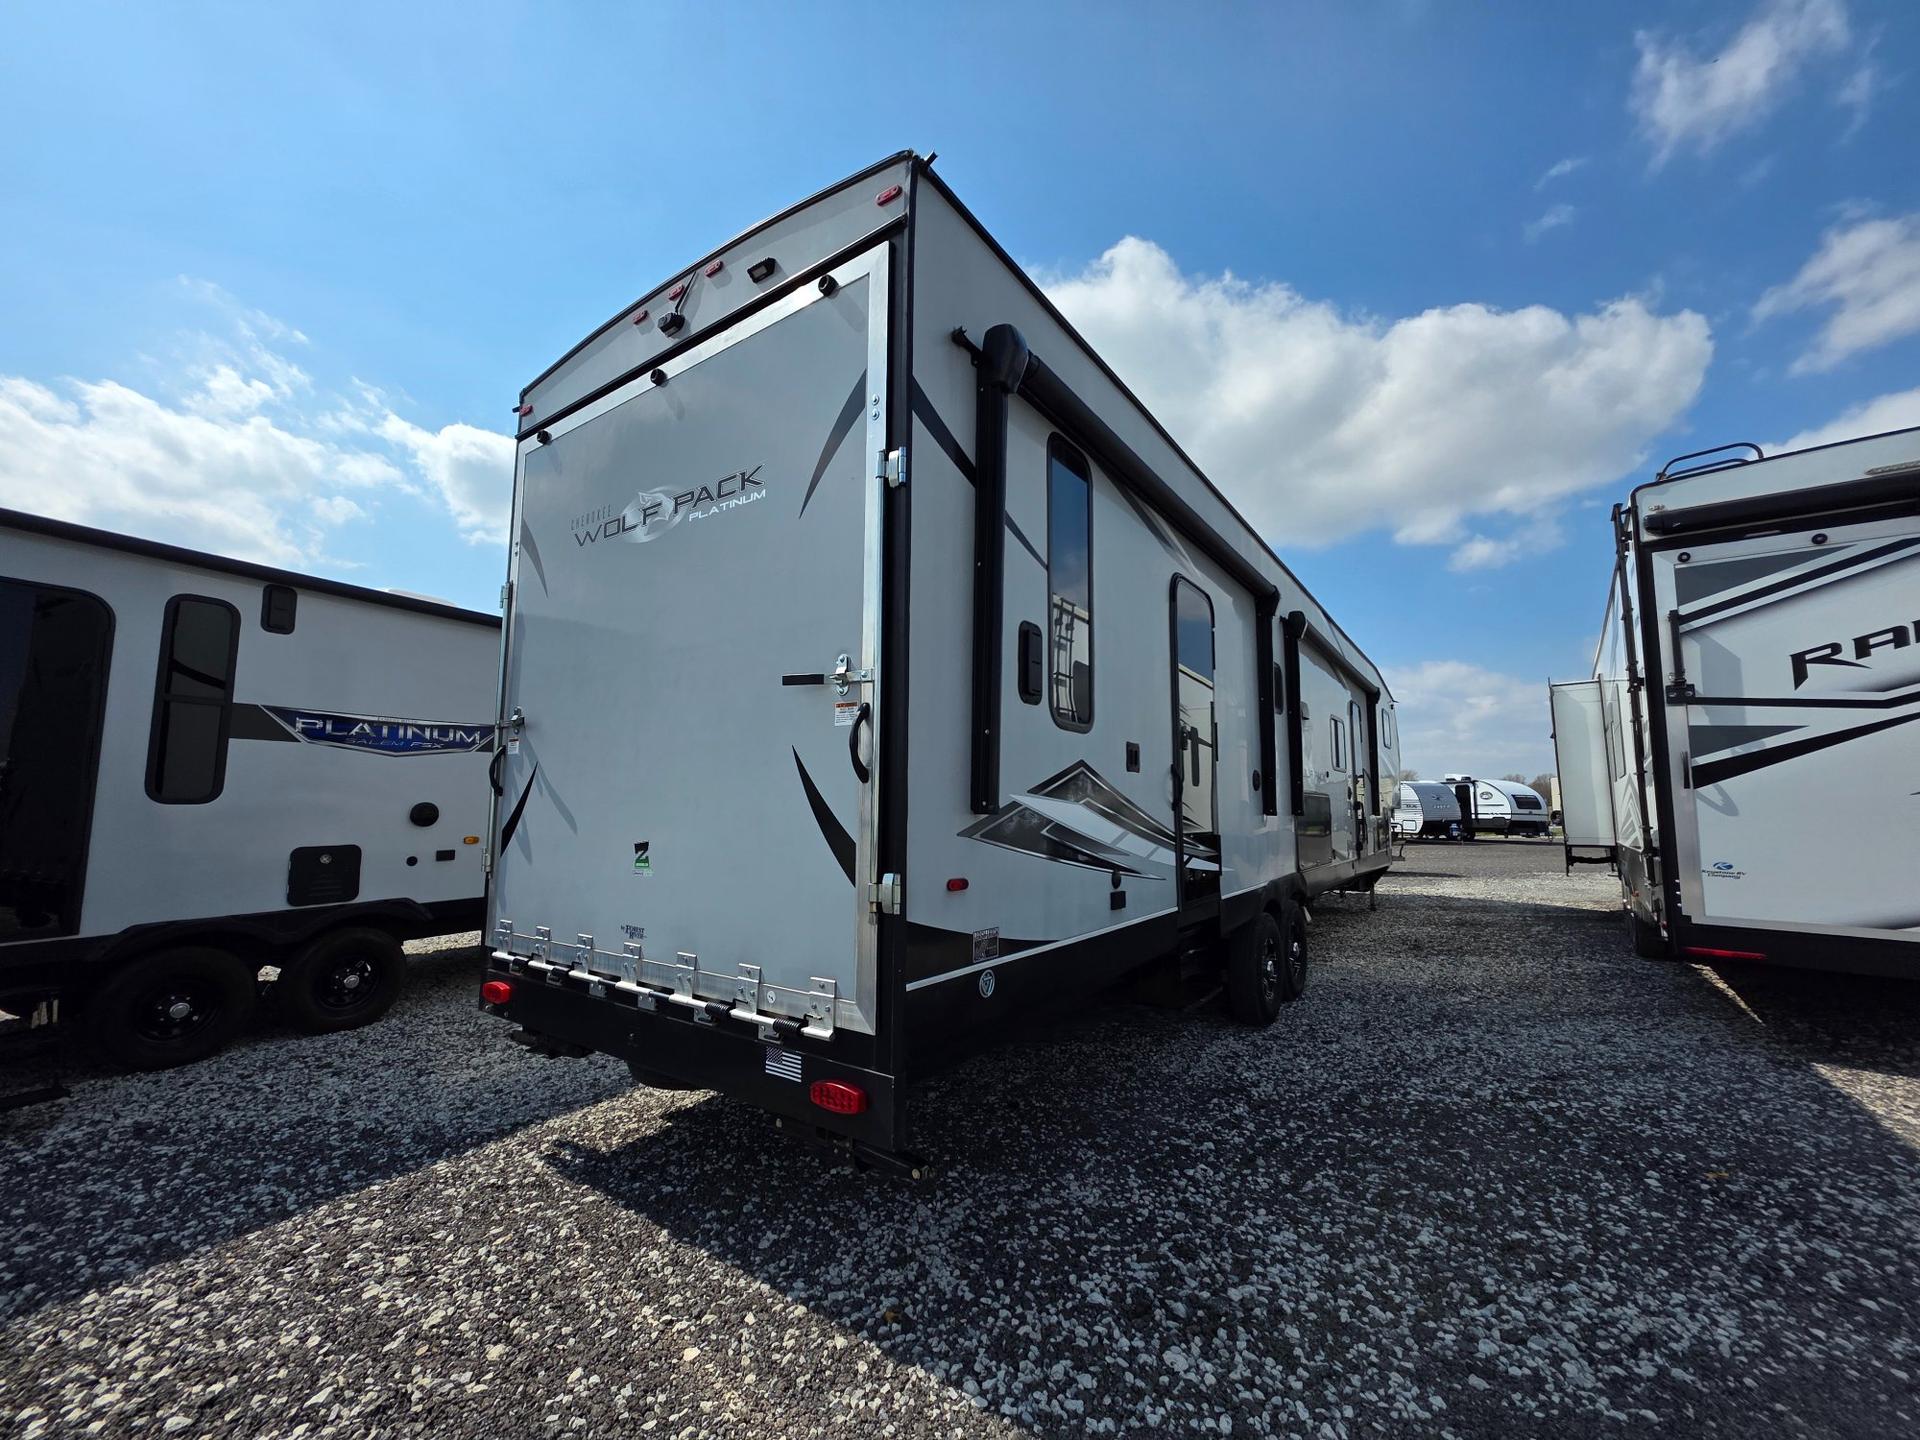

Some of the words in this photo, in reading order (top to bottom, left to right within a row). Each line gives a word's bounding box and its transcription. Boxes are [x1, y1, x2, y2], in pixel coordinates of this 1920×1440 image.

[574, 502, 663, 547] WOLF
[672, 464, 766, 515] PACK
[688, 489, 767, 522] PLATINUM
[1790, 618, 1920, 691] RA
[295, 716, 481, 745] PLATINUM
